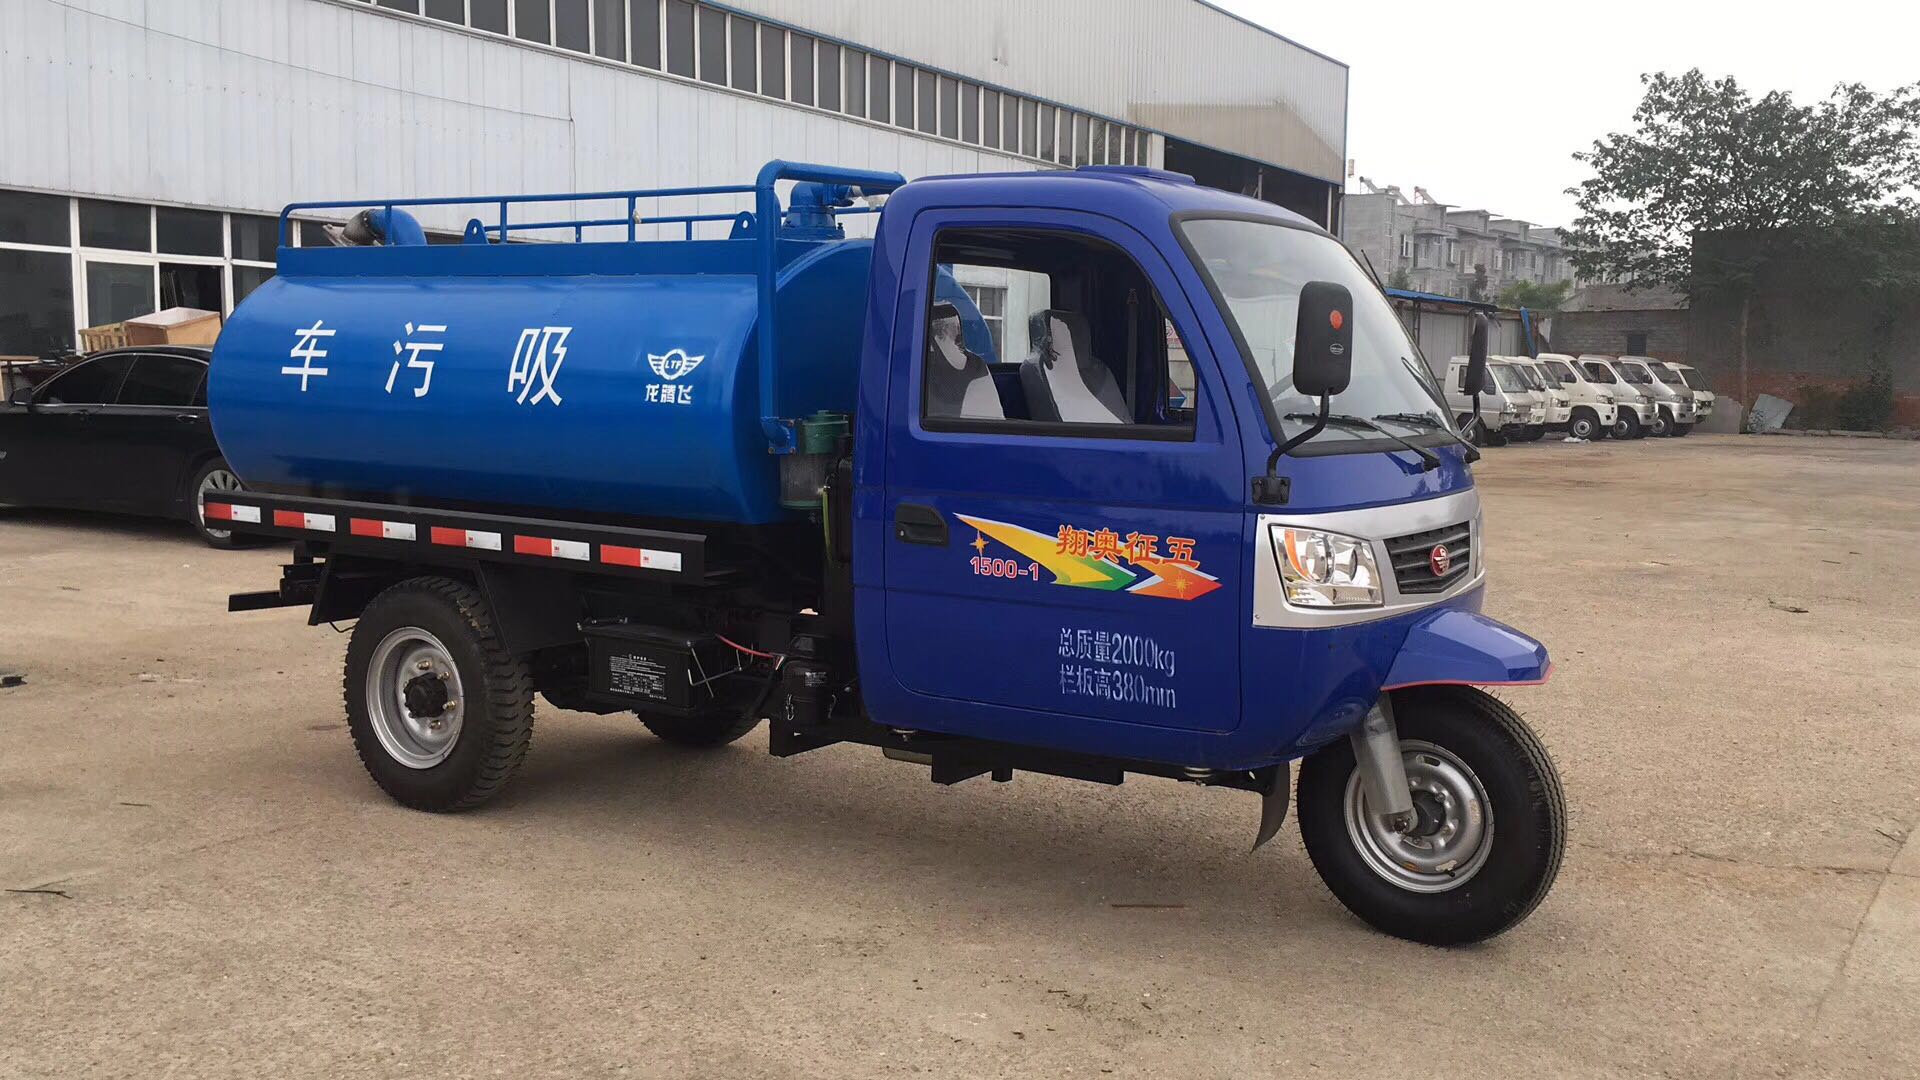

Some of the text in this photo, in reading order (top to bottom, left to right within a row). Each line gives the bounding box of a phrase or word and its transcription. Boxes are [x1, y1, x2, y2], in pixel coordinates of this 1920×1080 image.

[664, 360, 683, 370] LTF
[645, 384, 694, 405] 龙腾飞
[970, 556, 1039, 581] 1500-1
[1058, 627, 1175, 677] 总质量2000kg
[1059, 664, 1176, 708] 栏板高380mm
